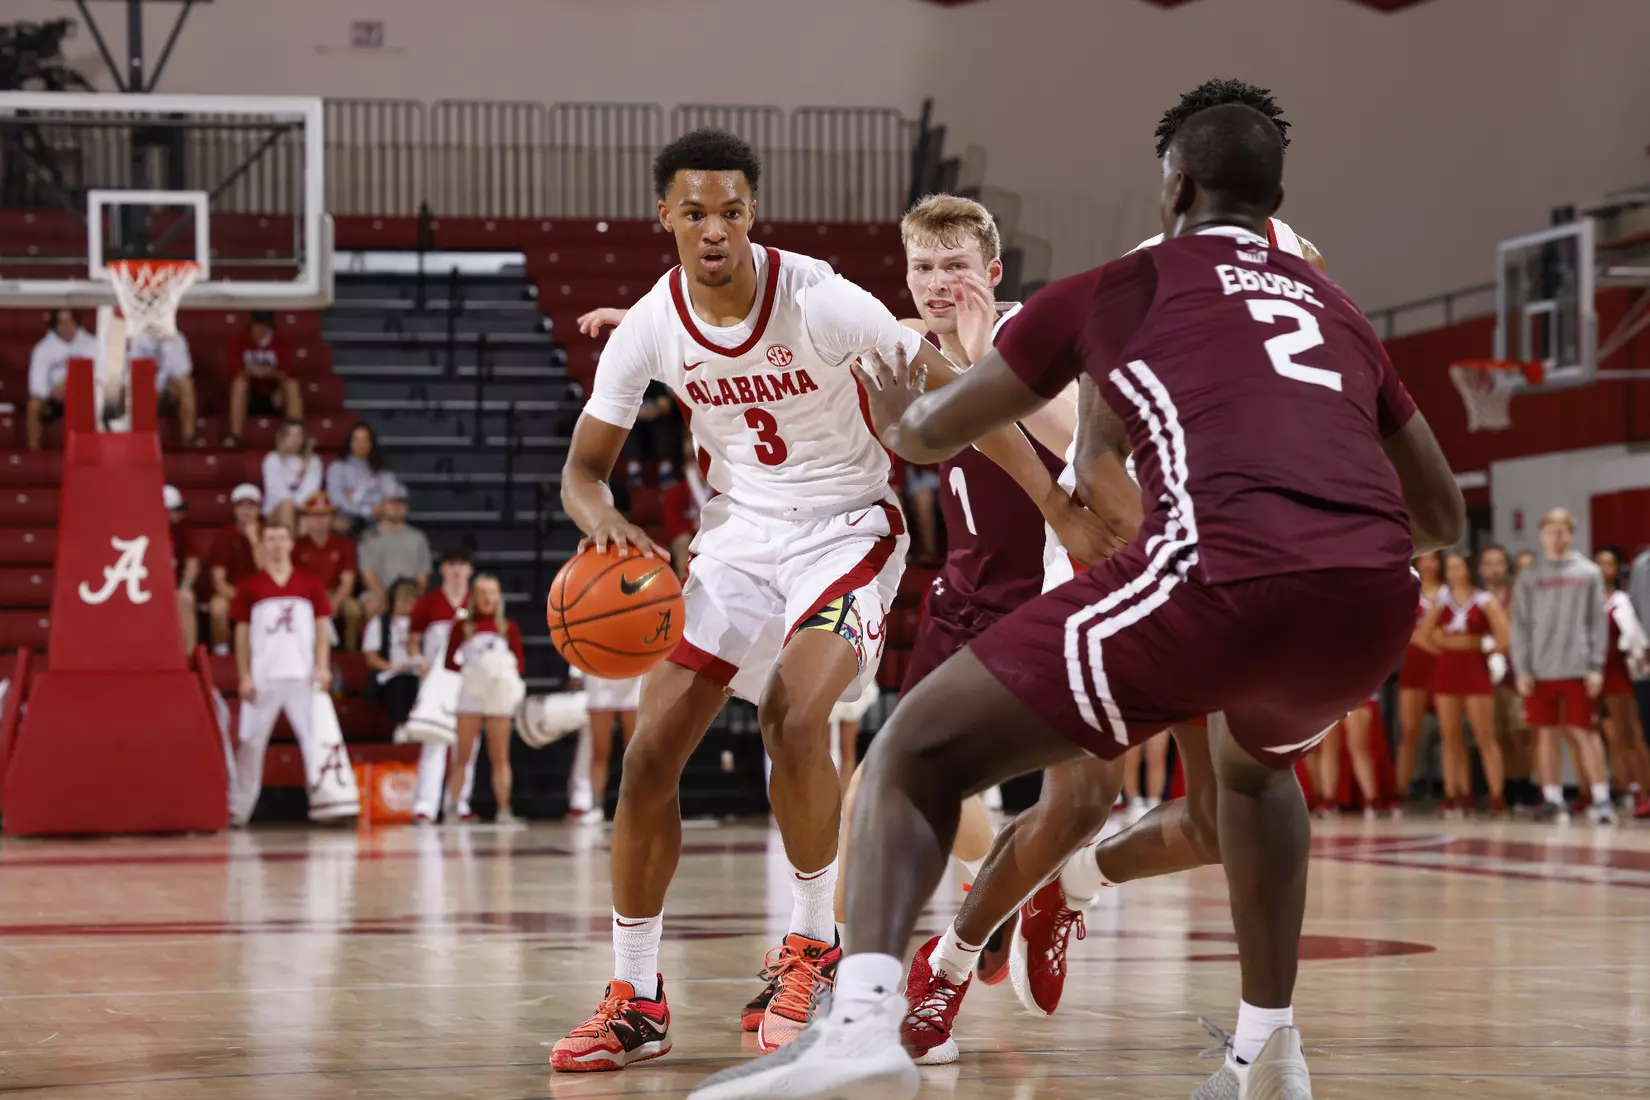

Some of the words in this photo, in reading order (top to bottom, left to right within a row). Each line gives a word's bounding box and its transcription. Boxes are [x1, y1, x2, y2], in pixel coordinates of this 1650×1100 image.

[767, 346, 792, 366] SEC
[1245, 299, 1342, 392] 2
[685, 369, 818, 407] ALABAMA
[744, 408, 788, 466] 3
[949, 466, 978, 536] 1
[78, 535, 152, 605] A
[644, 608, 672, 645] A
